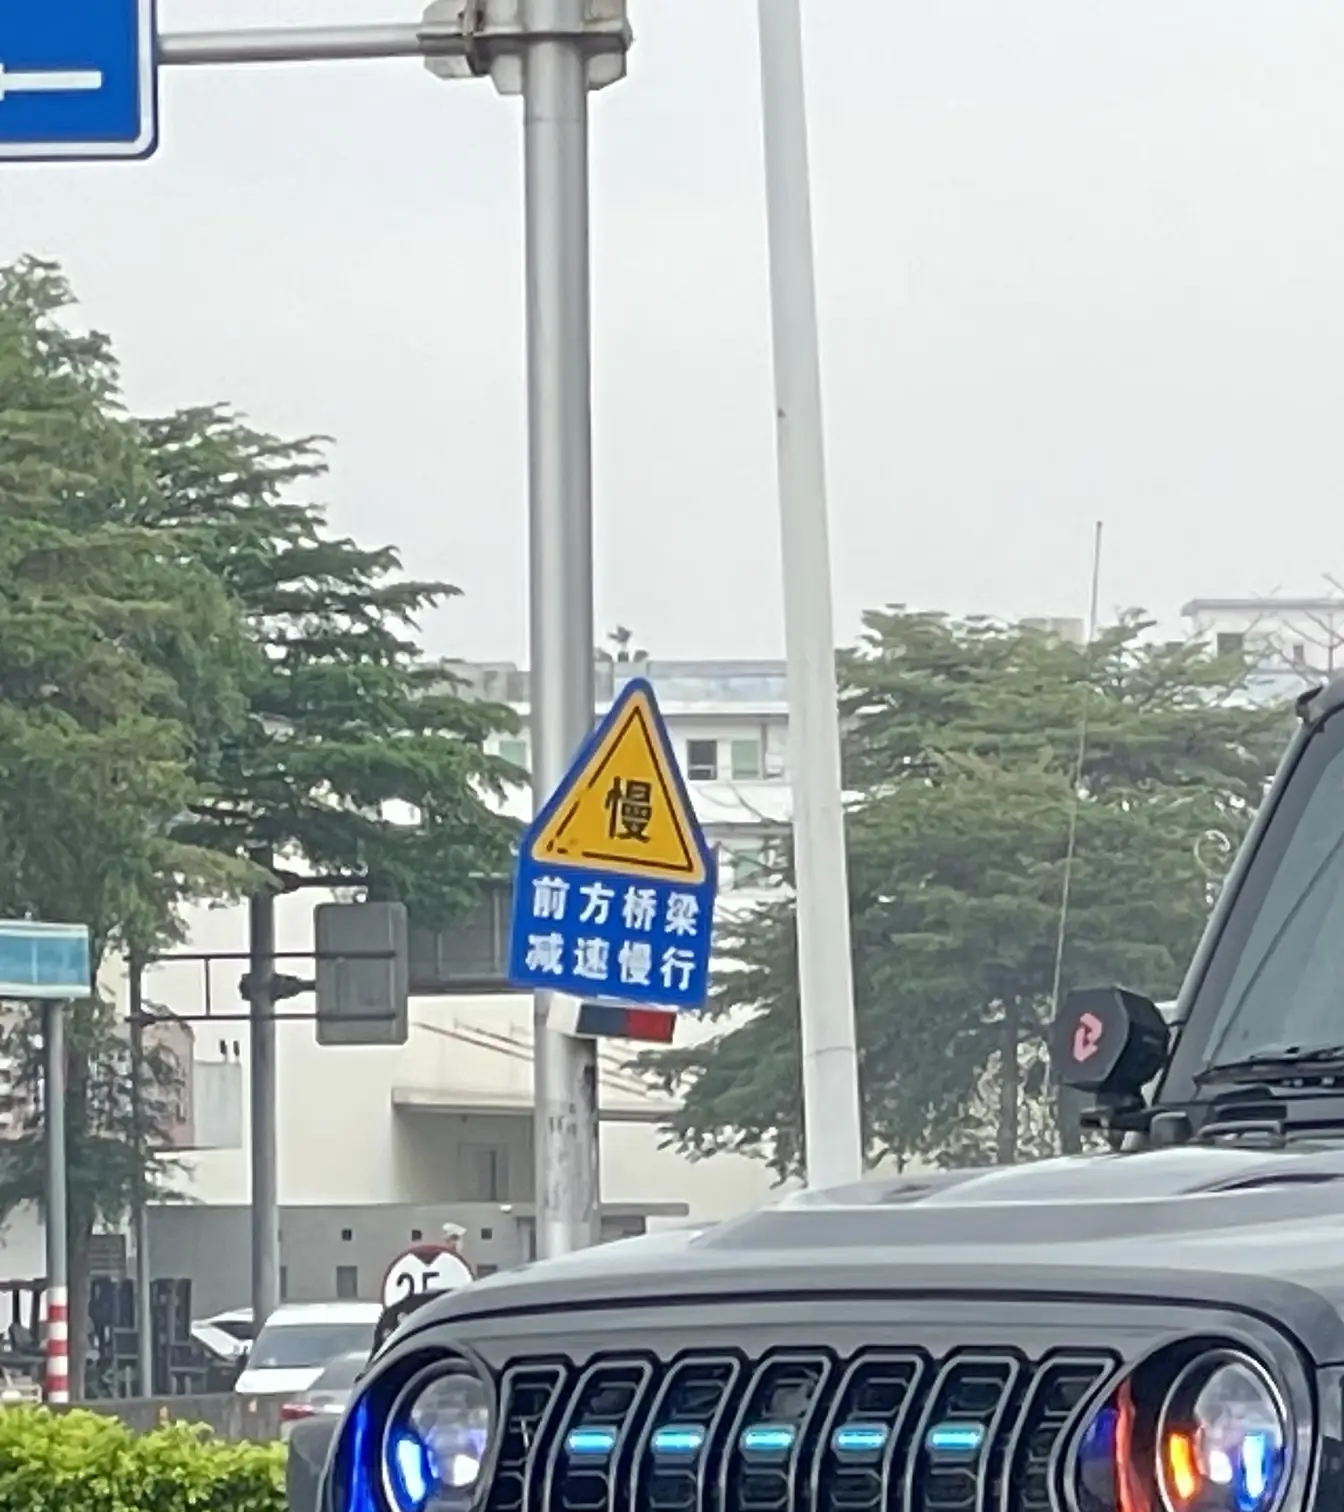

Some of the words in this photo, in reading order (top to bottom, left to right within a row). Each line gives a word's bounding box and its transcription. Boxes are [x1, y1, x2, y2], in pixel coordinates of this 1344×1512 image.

[605, 776, 652, 844] 慢
[531, 875, 701, 937] 前方桥梁
[524, 932, 697, 991] 减速慢行
